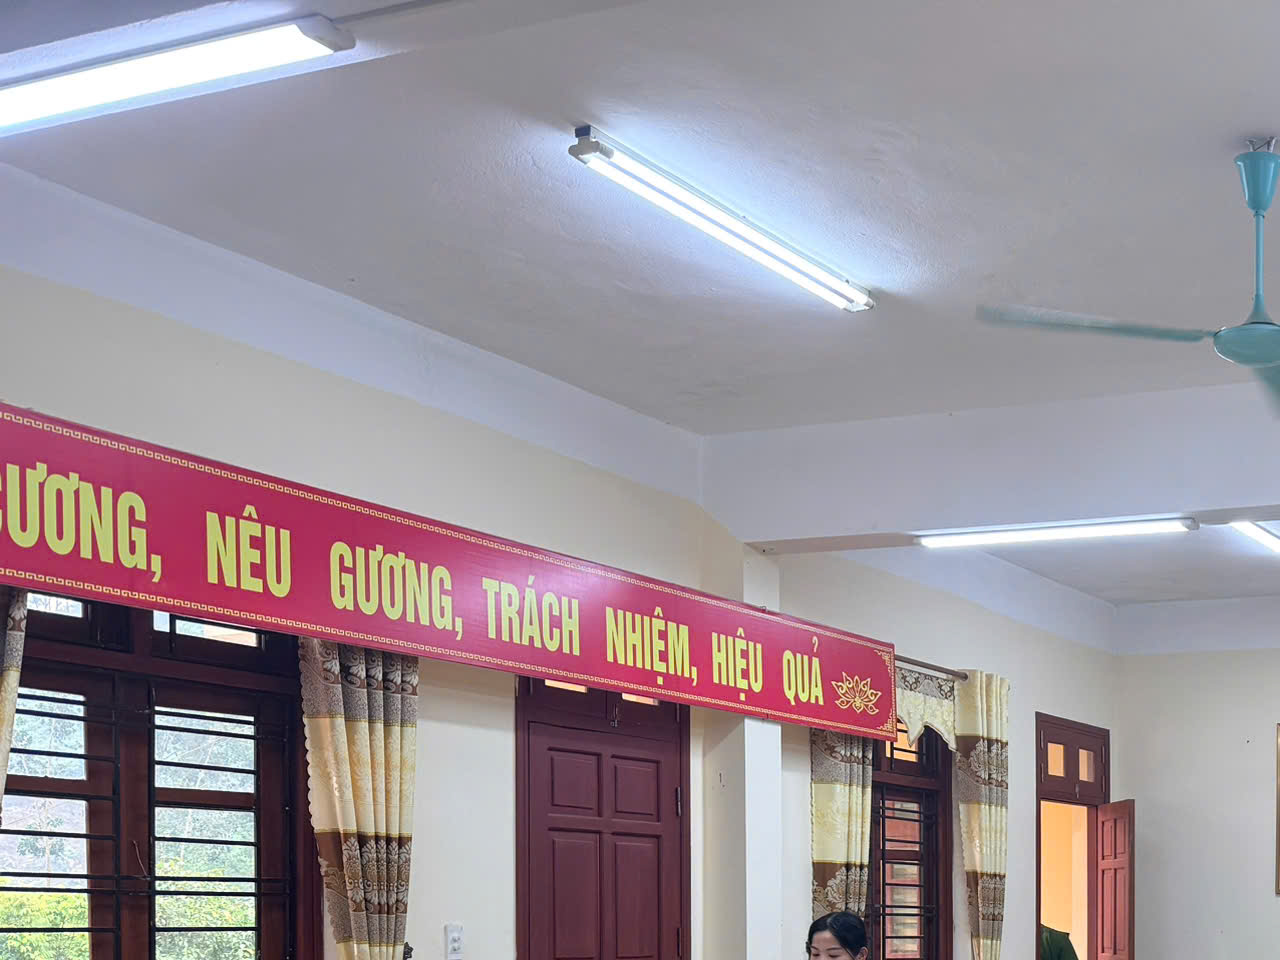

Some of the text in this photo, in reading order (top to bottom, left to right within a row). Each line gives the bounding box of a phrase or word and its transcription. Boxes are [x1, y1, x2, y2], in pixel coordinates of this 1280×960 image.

[0, 462, 825, 706] ƯƠNG, NÊU GƯƠNG, TRÁCH NHIỆM, HIỆU QUẢ
